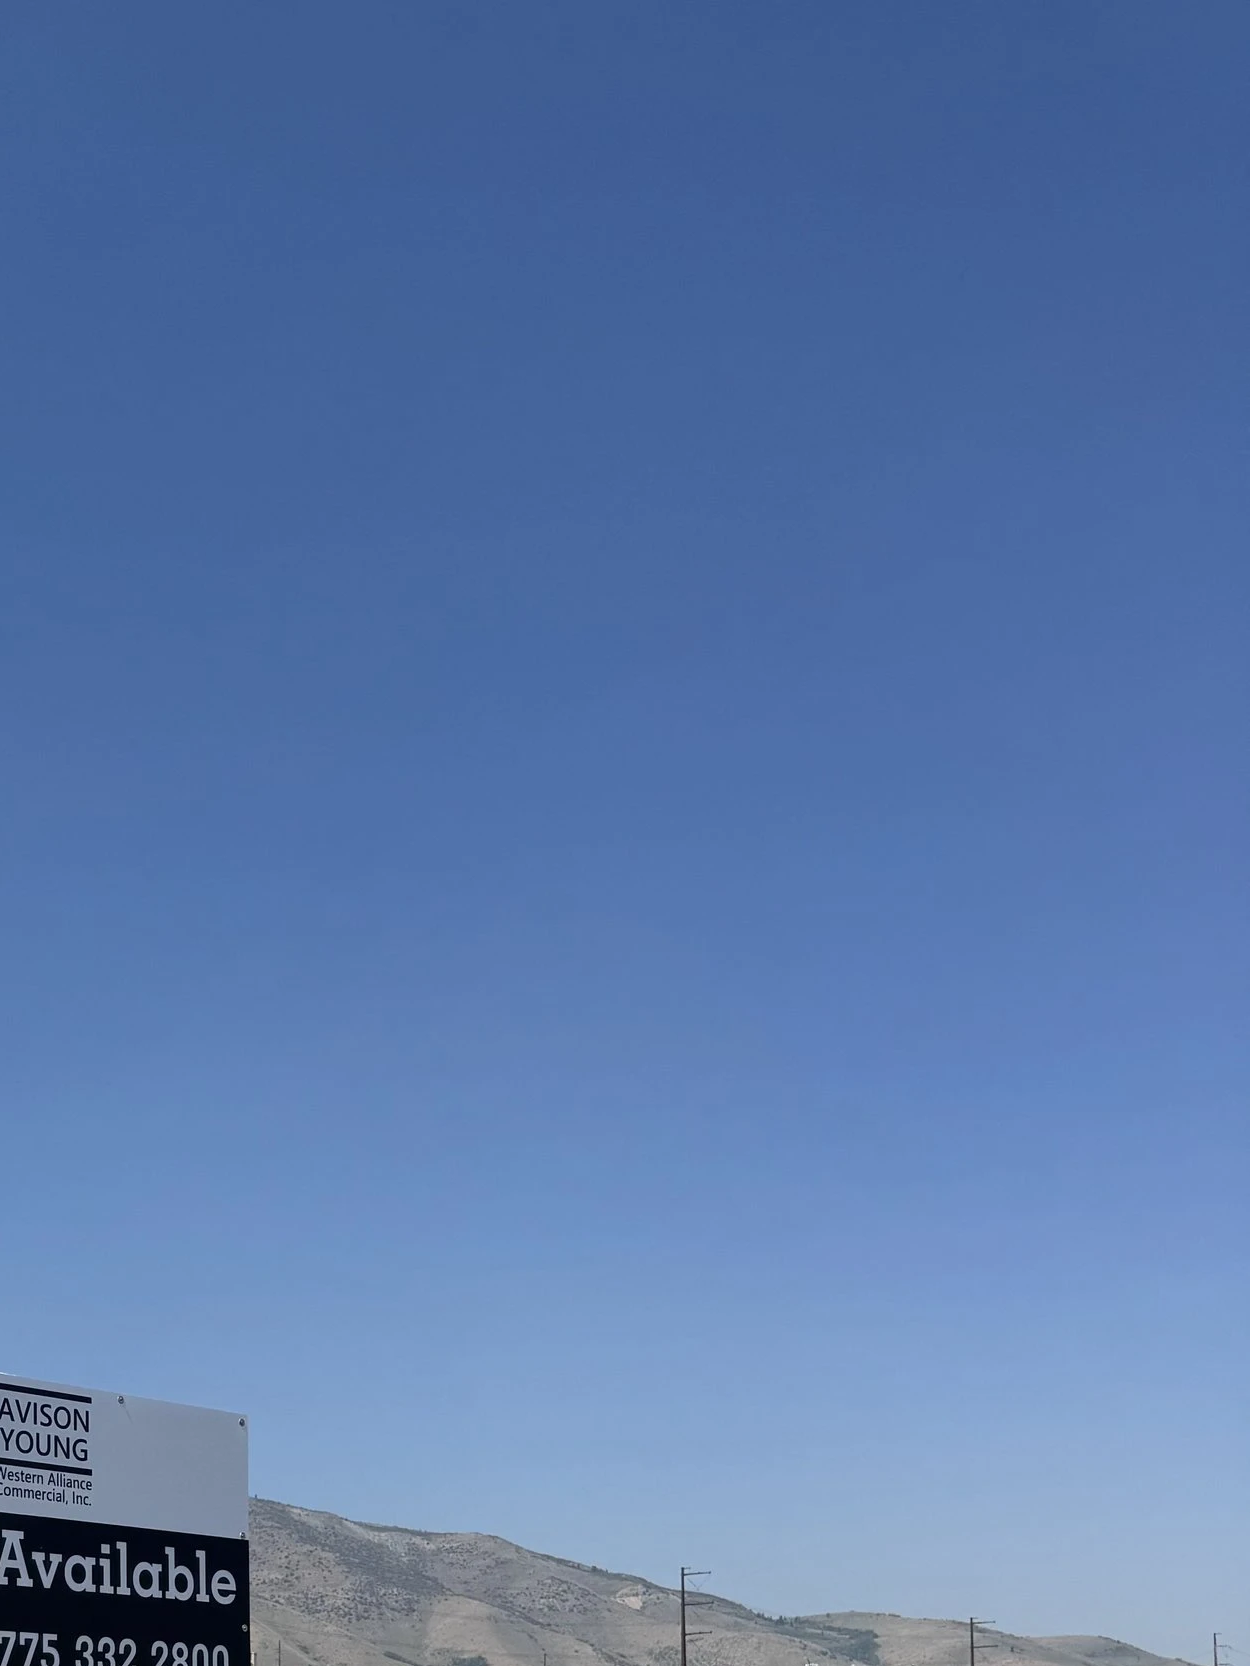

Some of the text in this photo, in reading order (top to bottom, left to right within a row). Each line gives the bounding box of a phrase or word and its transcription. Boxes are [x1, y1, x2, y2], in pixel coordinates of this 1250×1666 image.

[0, 1427, 89, 1462] YOUNG
[47, 1470, 93, 1491] Alliance
[72, 1491, 92, 1507] Inc.
